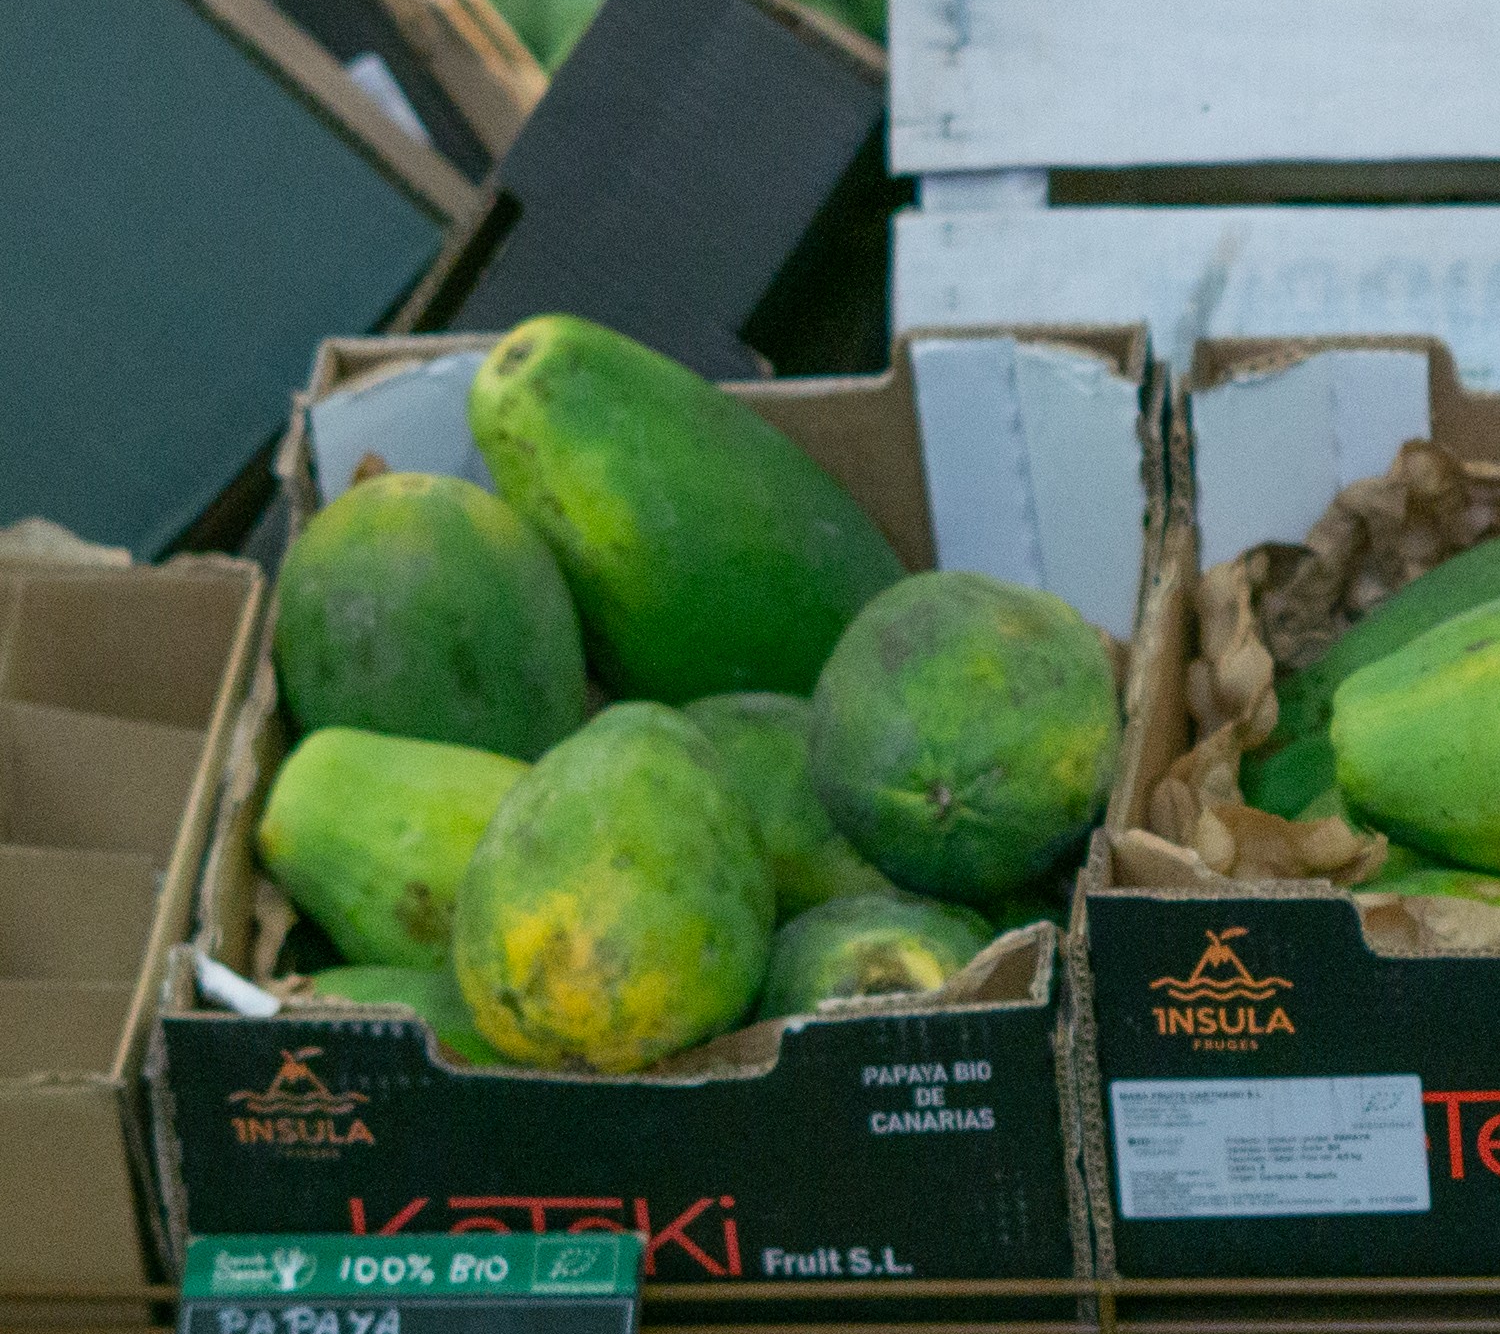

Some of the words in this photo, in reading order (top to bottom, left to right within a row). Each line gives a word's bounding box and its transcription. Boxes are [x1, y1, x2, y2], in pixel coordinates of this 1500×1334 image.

[862, 1062, 949, 1087] PAPAYA
[953, 1060, 993, 1083] BIO
[914, 1086, 946, 1108] DE
[869, 1107, 996, 1135] CANARIAS
[339, 1254, 435, 1285] 100%
[450, 1253, 509, 1283] BIO
[761, 1247, 843, 1277] Fruit
[848, 1246, 915, 1276] S.L.
